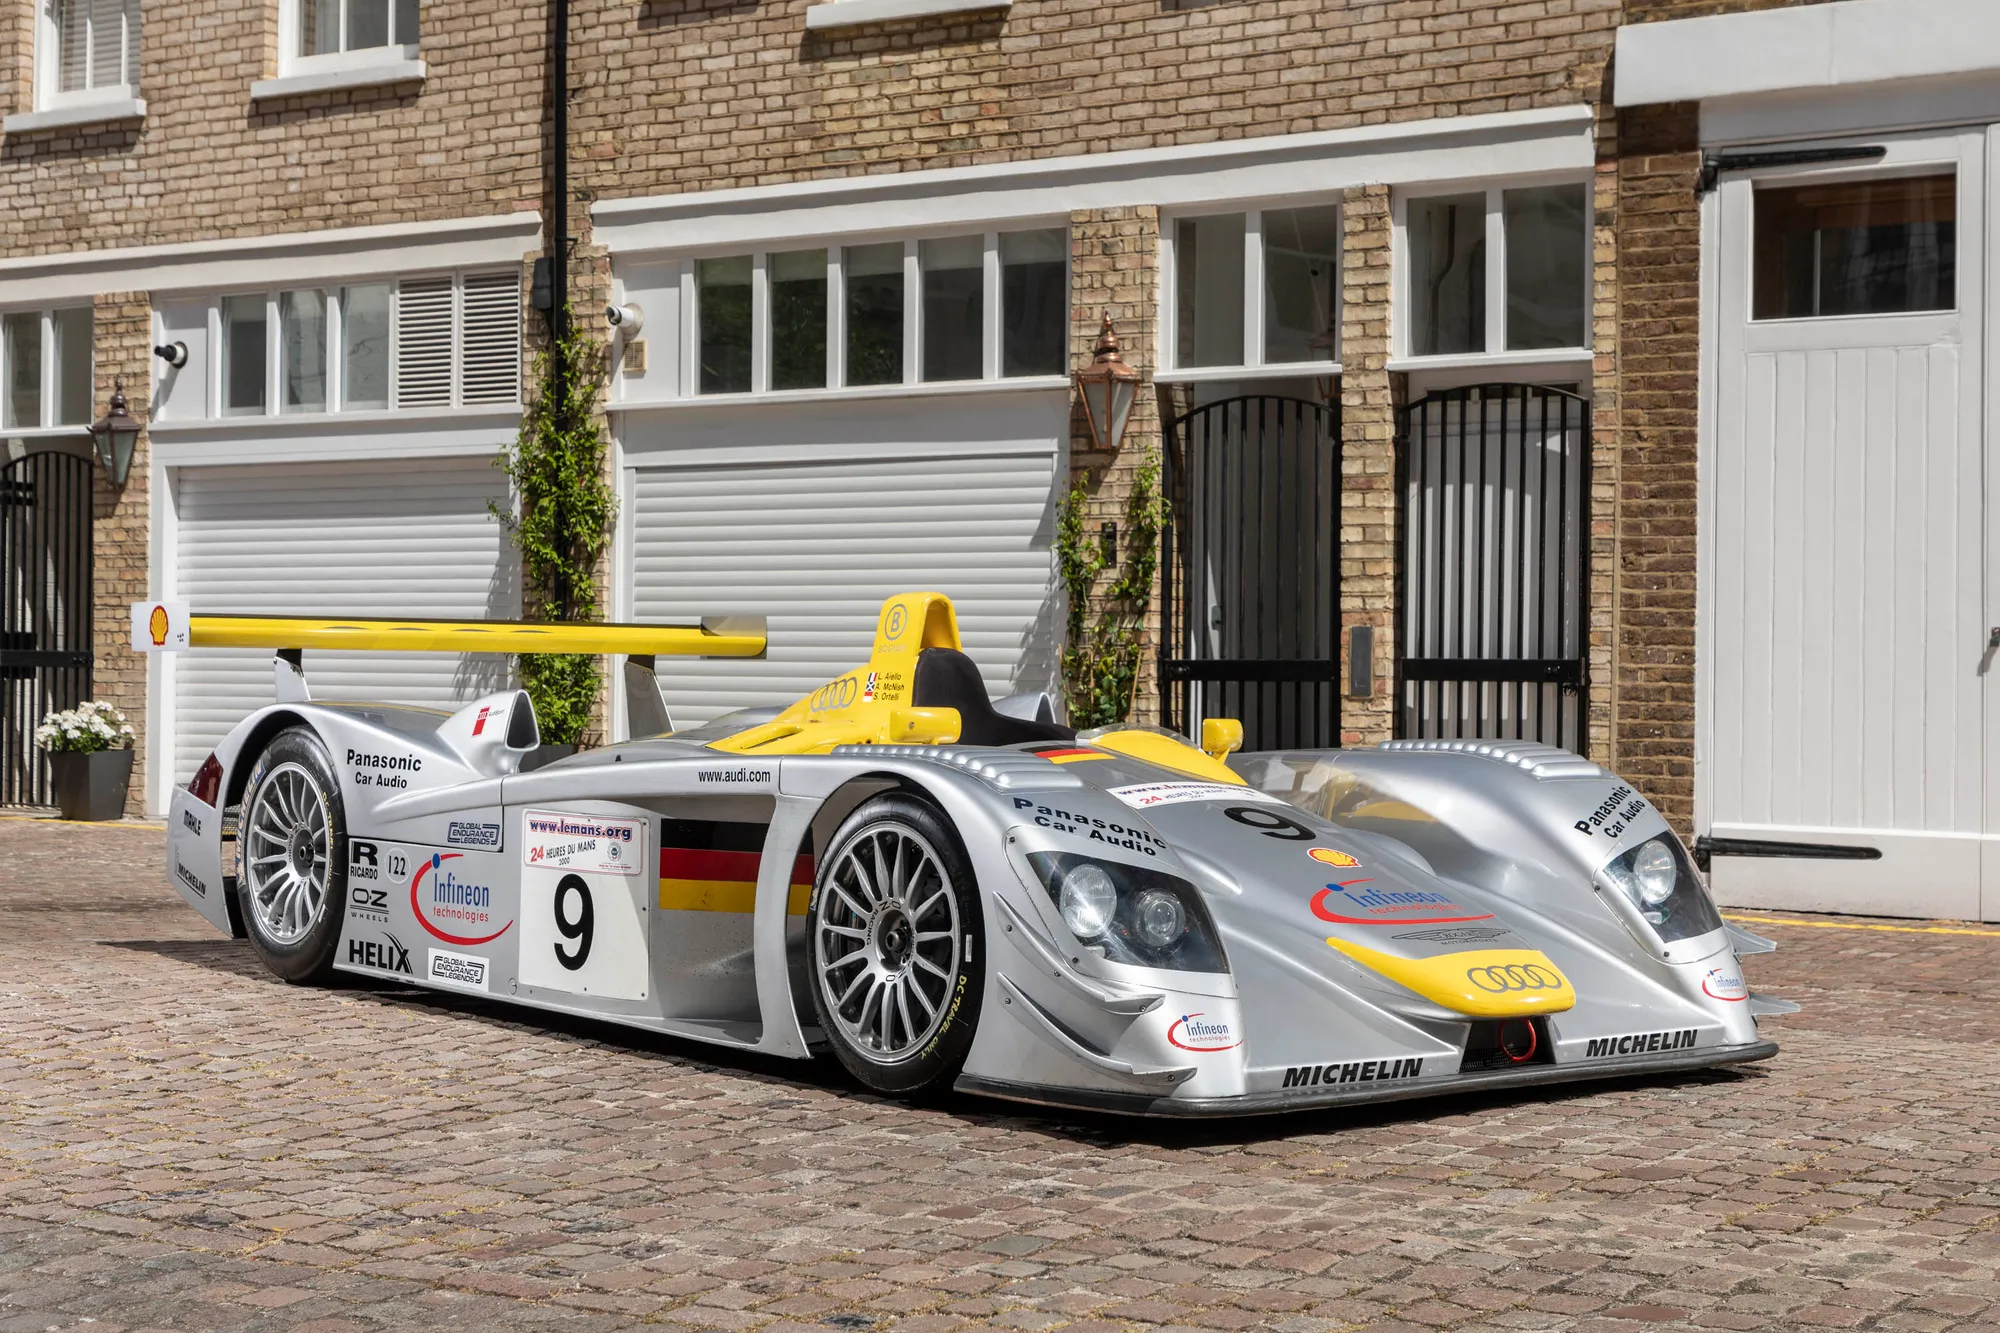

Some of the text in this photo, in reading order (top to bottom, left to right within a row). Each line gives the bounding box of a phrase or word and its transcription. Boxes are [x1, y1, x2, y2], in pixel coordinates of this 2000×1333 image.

[890, 611, 901, 632] B
[884, 672, 901, 681] Aiello
[873, 692, 899, 701] S. Ortelli
[883, 683, 905, 691] McNish
[347, 749, 422, 772] Panasonic
[355, 772, 408, 789] Car Audio
[698, 767, 771, 784] www.audi.com
[1139, 795, 1163, 805] 24
[1574, 785, 1631, 836] Panasonic
[1604, 799, 1646, 839] Car Audio
[458, 822, 482, 831] GLOBAL
[529, 819, 632, 842] www.lemans.org
[1013, 797, 1168, 850] Panasonic
[1223, 806, 1317, 841] 9
[452, 830, 495, 839] ENDURANCE
[460, 837, 491, 846] LEGENDS
[1034, 815, 1157, 857] Car Audio
[351, 841, 379, 867] R
[530, 839, 596, 862] 24 HEURES DU MANS
[388, 855, 406, 876] 122
[558, 857, 570, 866] 2000
[178, 862, 206, 896] MICHELIN
[350, 866, 379, 880] RICARDO
[434, 872, 489, 907] Infineon
[1343, 888, 1452, 908] Infineon
[351, 912, 389, 923] WHEELS
[433, 905, 489, 924] technologies
[1368, 902, 1463, 915] technologies
[553, 873, 594, 971] 9
[866, 908, 879, 946] RACING
[349, 933, 414, 974] HELIX
[443, 956, 466, 967] GLOBAL
[436, 964, 479, 977] ENDURANCE
[444, 972, 476, 983] LEGENDS
[1713, 975, 1741, 988] Infineon
[920, 974, 967, 1060] DC TRAVEL ONLY
[1186, 1021, 1229, 1037] Infineon
[1189, 1035, 1231, 1043] technologies
[1585, 1029, 1698, 1057] MICHELIN
[1282, 1057, 1424, 1088] MICHELIN
